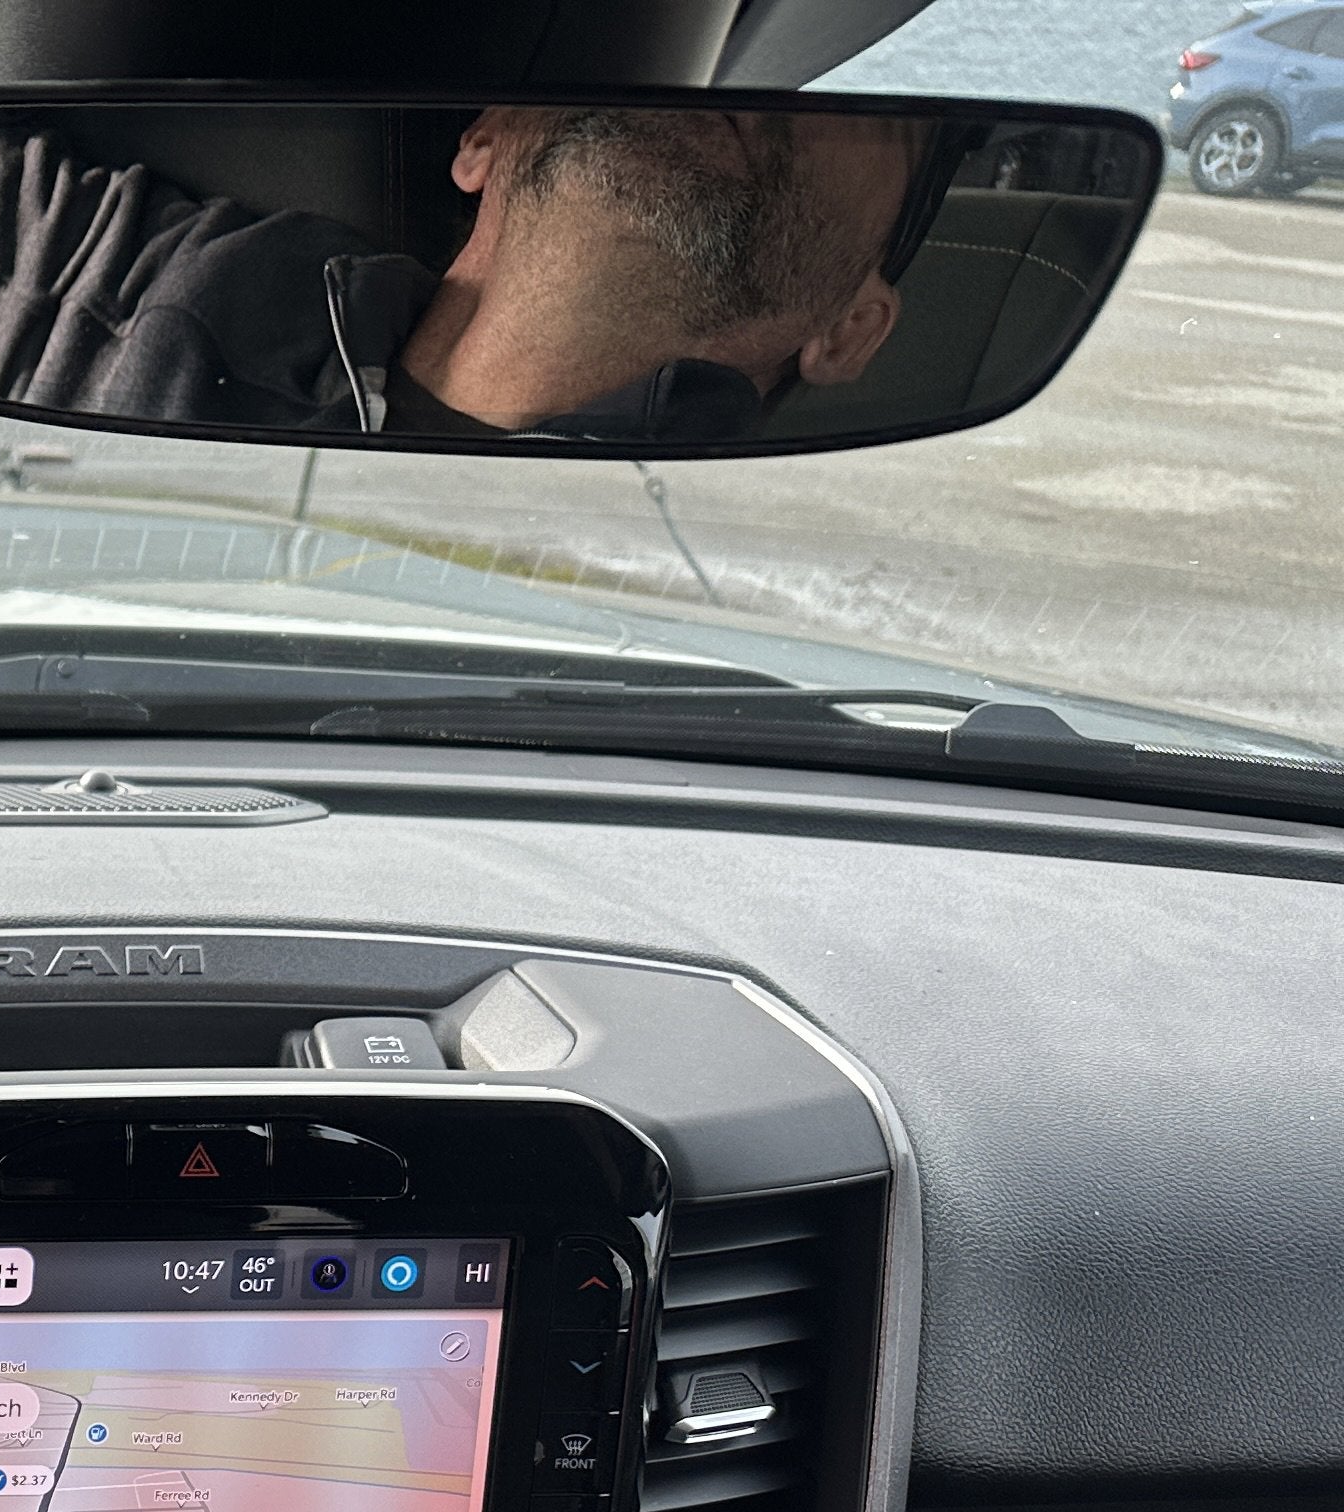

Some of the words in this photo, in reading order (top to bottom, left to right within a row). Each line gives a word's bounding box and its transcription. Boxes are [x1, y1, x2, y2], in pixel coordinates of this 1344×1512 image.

[368, 1055, 389, 1064] 12V
[393, 1055, 411, 1064] DC
[162, 1260, 225, 1281] 10:47
[242, 1256, 275, 1274] 46°
[465, 1263, 490, 1283] HI
[239, 1278, 274, 1292] OUT
[1, 1361, 26, 1373] Blvd
[230, 1391, 281, 1403] Kennedy
[284, 1391, 300, 1401] Dr
[337, 1389, 378, 1402] Harper
[381, 1389, 396, 1400] Rd
[133, 1433, 163, 1444] Ward
[166, 1433, 182, 1443] Rd
[554, 1458, 596, 1469] FRONT
[12, 1474, 47, 1487] $2.37
[155, 1490, 191, 1501] Ferree
[194, 1490, 209, 1500] Rd
